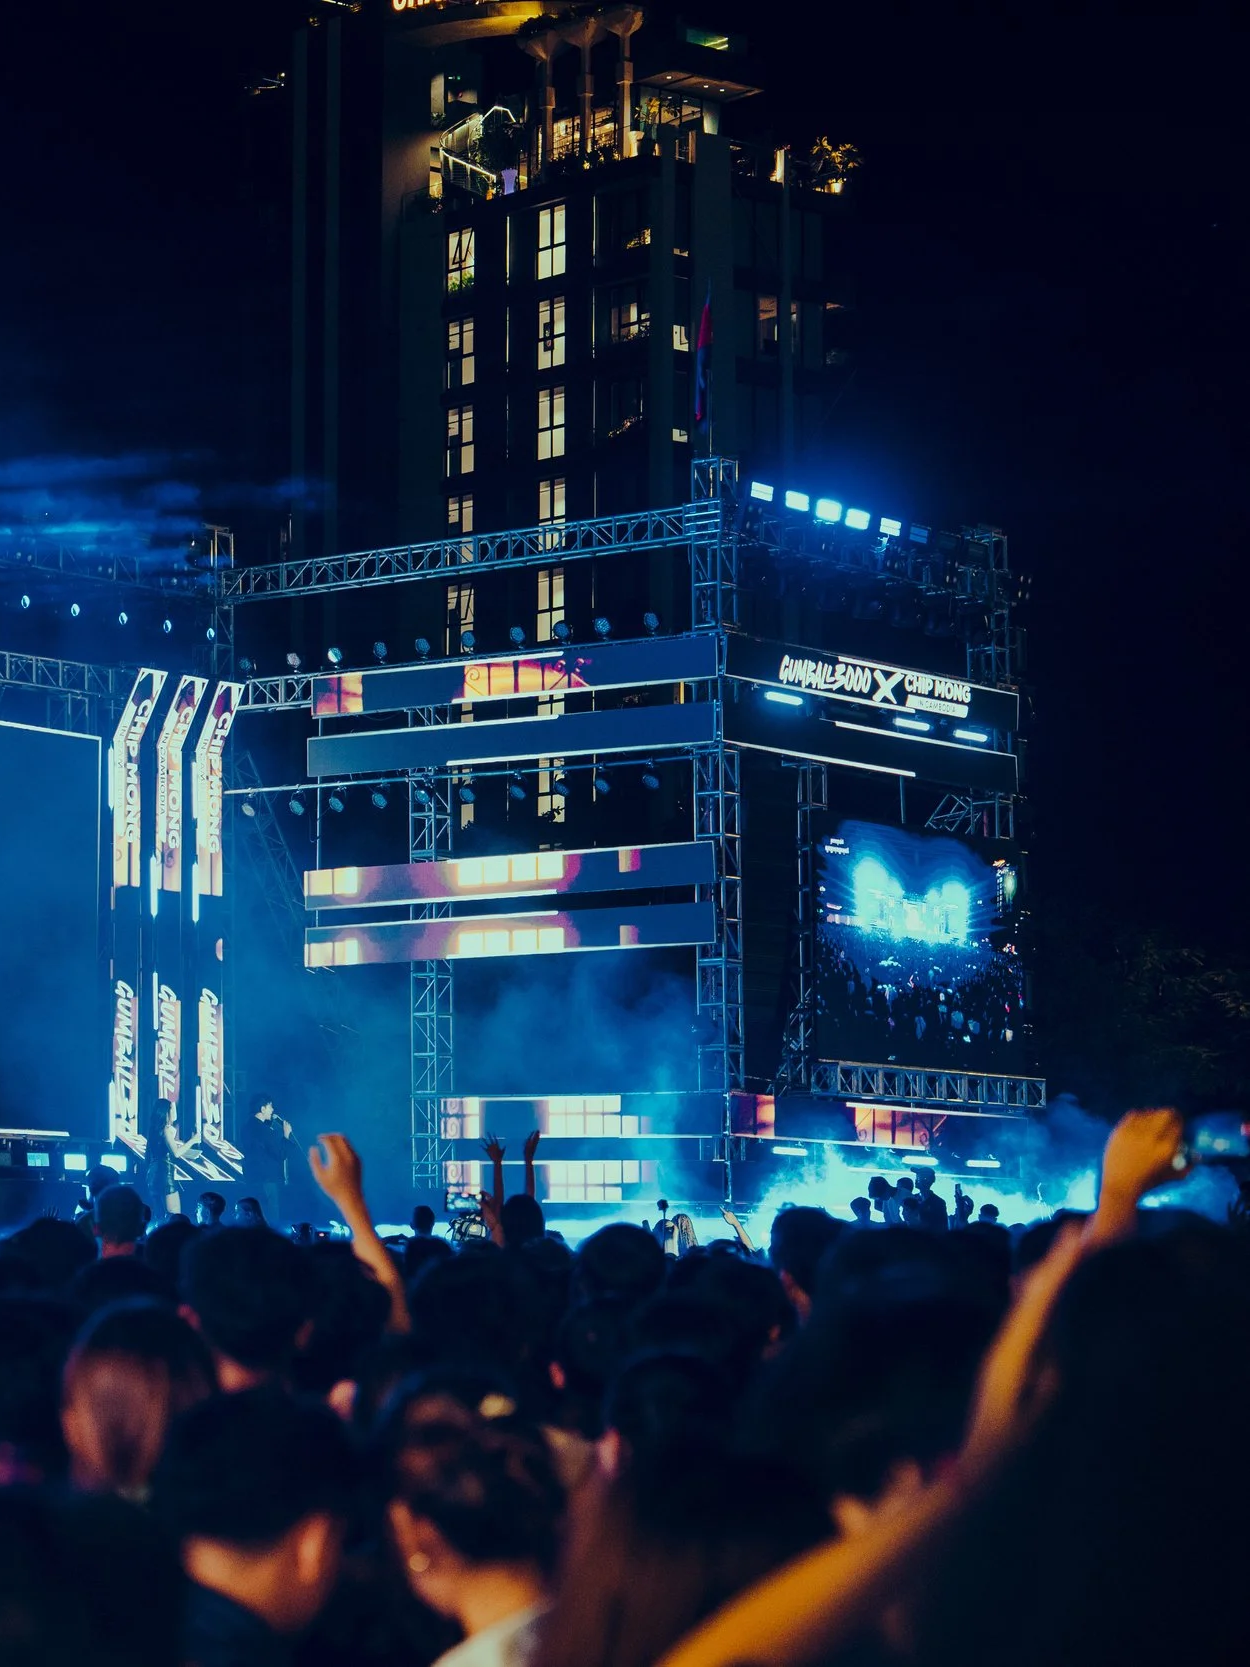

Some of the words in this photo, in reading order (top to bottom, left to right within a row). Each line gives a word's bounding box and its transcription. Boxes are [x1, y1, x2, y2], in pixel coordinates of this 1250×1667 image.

[778, 655, 872, 694] GUMBALL3000
[872, 669, 905, 705] X
[904, 674, 933, 695] CHIP
[934, 680, 971, 703] MONG
[126, 699, 151, 758] CHIP
[161, 732, 170, 745] IN
[167, 706, 193, 767] CHIP
[208, 712, 232, 772] CHIP
[126, 763, 139, 843] MONG
[168, 770, 181, 849] MONG
[209, 775, 220, 854] MONG
